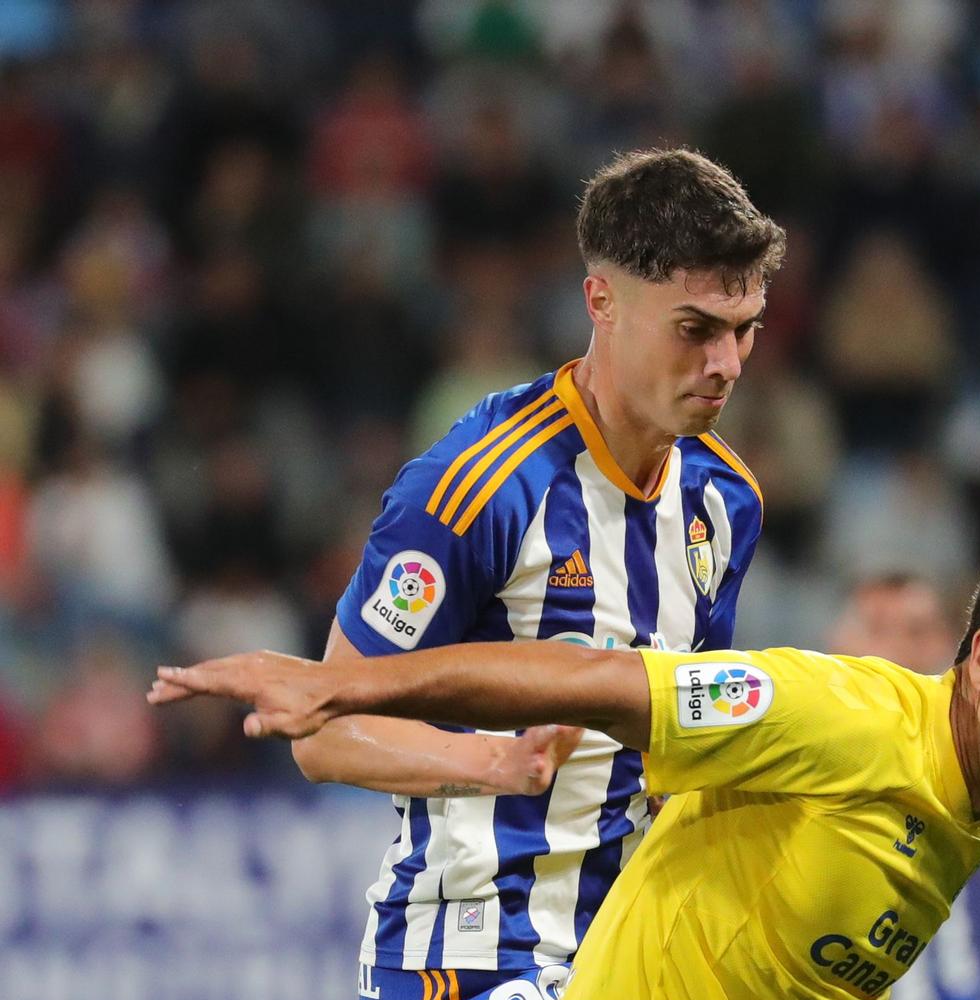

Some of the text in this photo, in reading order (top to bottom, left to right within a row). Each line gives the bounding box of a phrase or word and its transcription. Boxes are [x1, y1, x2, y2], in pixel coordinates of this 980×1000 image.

[549, 574, 593, 587] adidas
[373, 599, 417, 637] LaLiga
[688, 669, 705, 721] LaLiga
